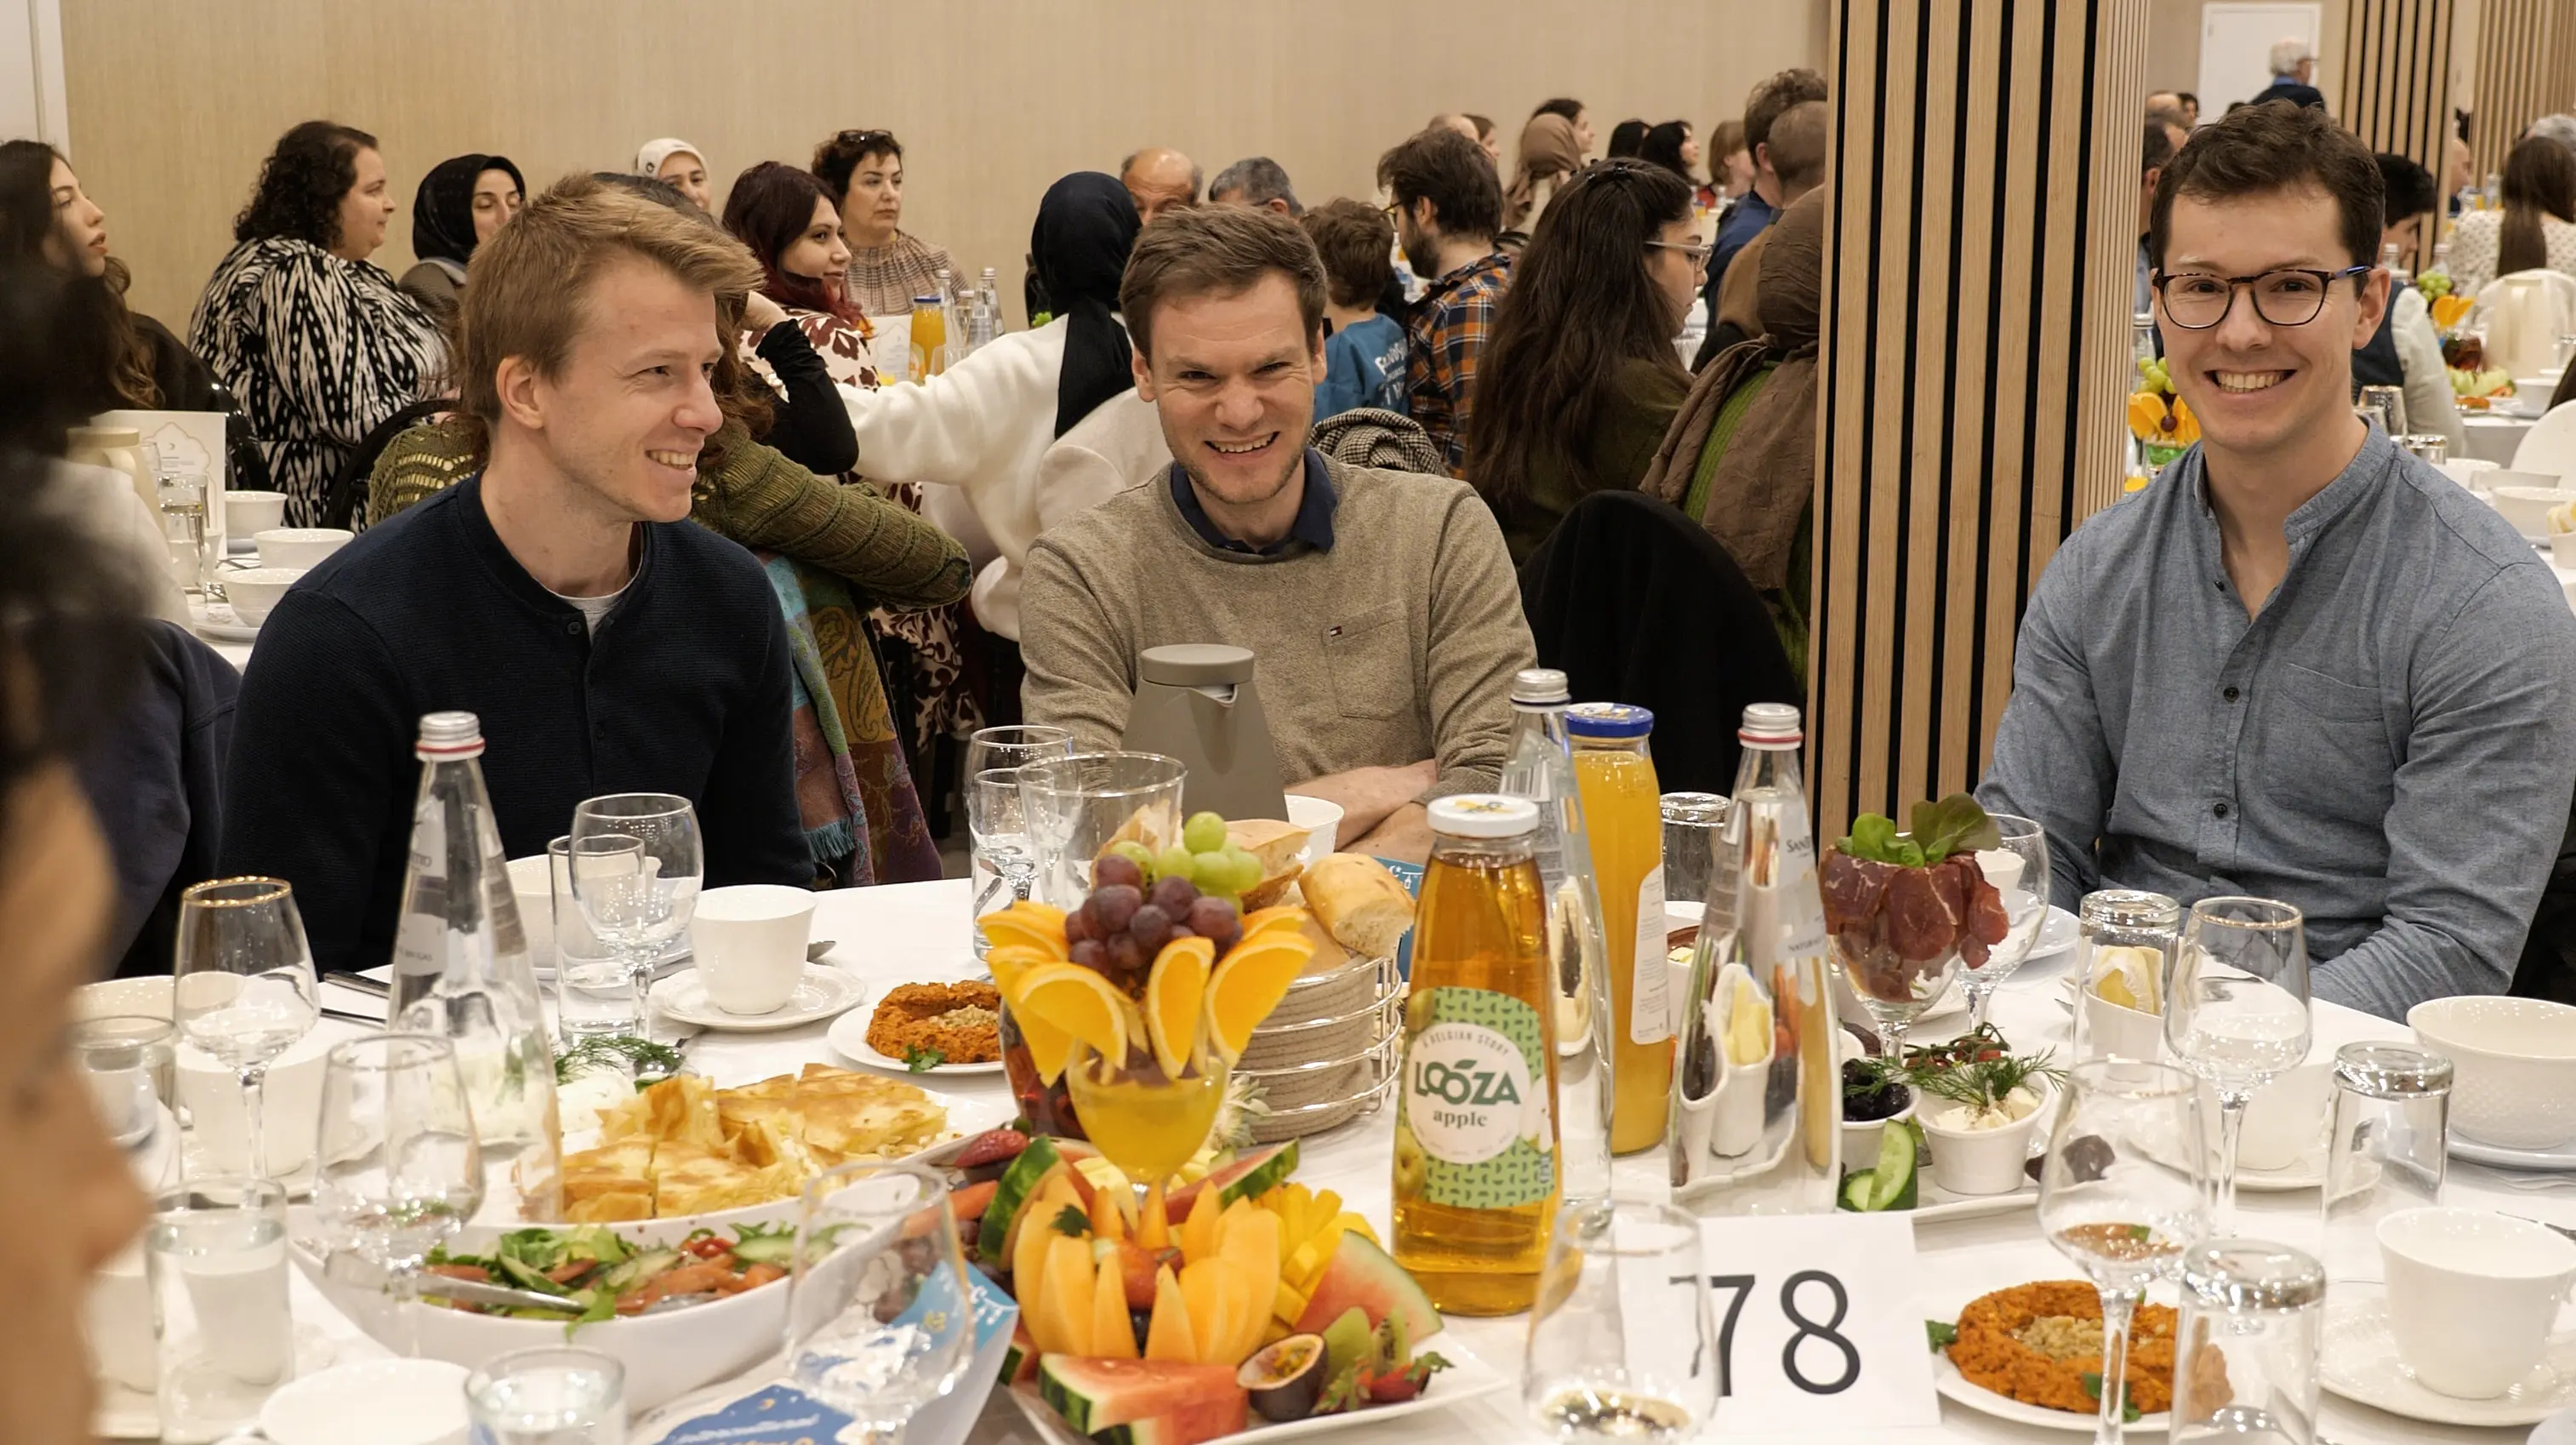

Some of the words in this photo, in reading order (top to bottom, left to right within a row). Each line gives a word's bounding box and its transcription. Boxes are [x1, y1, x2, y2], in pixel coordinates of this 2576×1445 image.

[1429, 1031, 1472, 1045] BELGIAN
[1477, 1034, 1509, 1055] STORY
[1433, 1110, 1488, 1128] apple
[1669, 1269, 1861, 1397] 78
